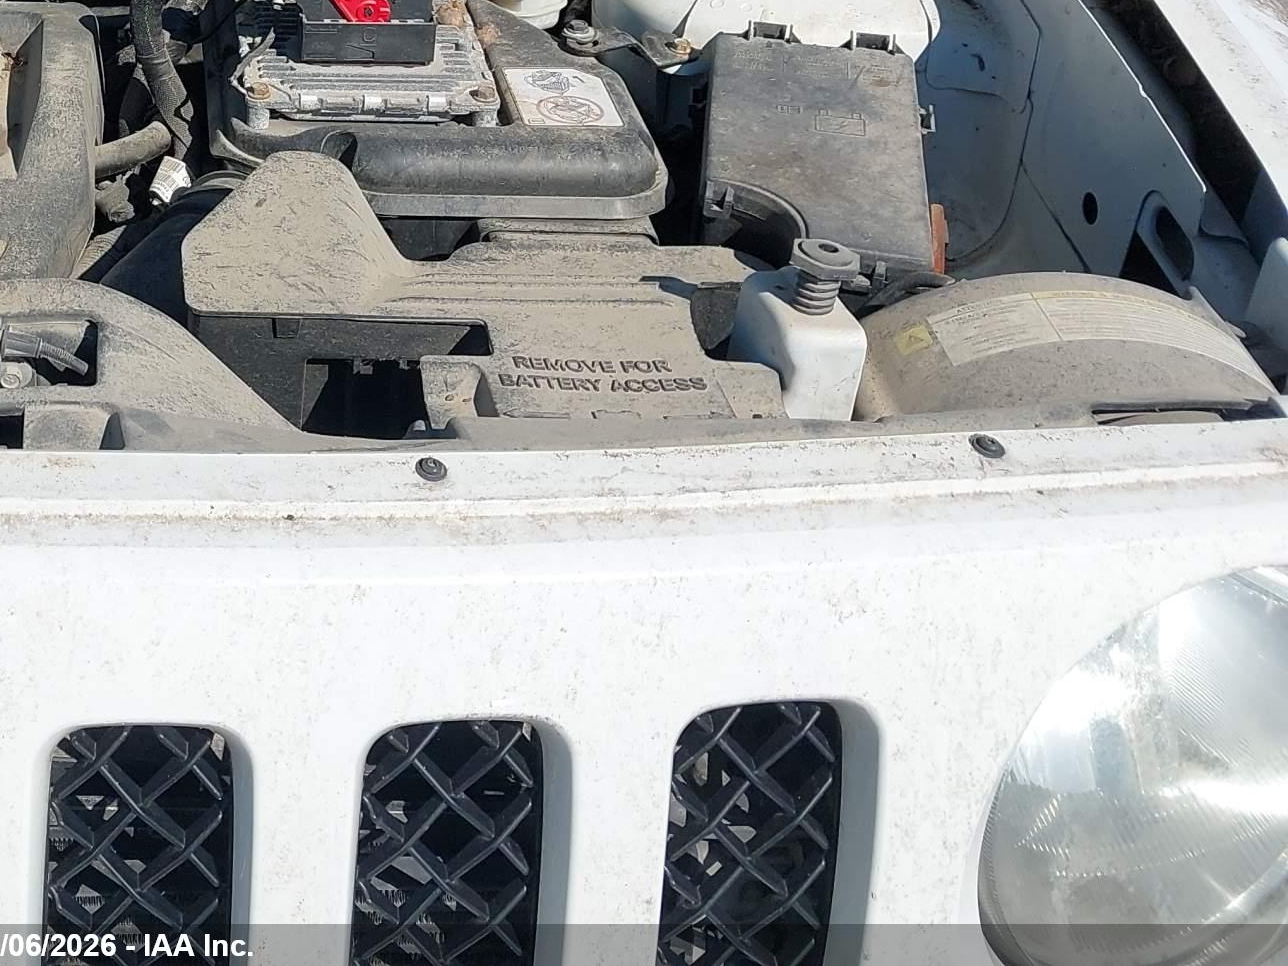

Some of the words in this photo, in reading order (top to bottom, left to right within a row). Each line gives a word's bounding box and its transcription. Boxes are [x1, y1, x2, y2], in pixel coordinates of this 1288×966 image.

[511, 355, 617, 374] REMOVE
[619, 359, 673, 374] FOR
[498, 373, 602, 392] BATTERY
[610, 376, 708, 393] ACCESS
